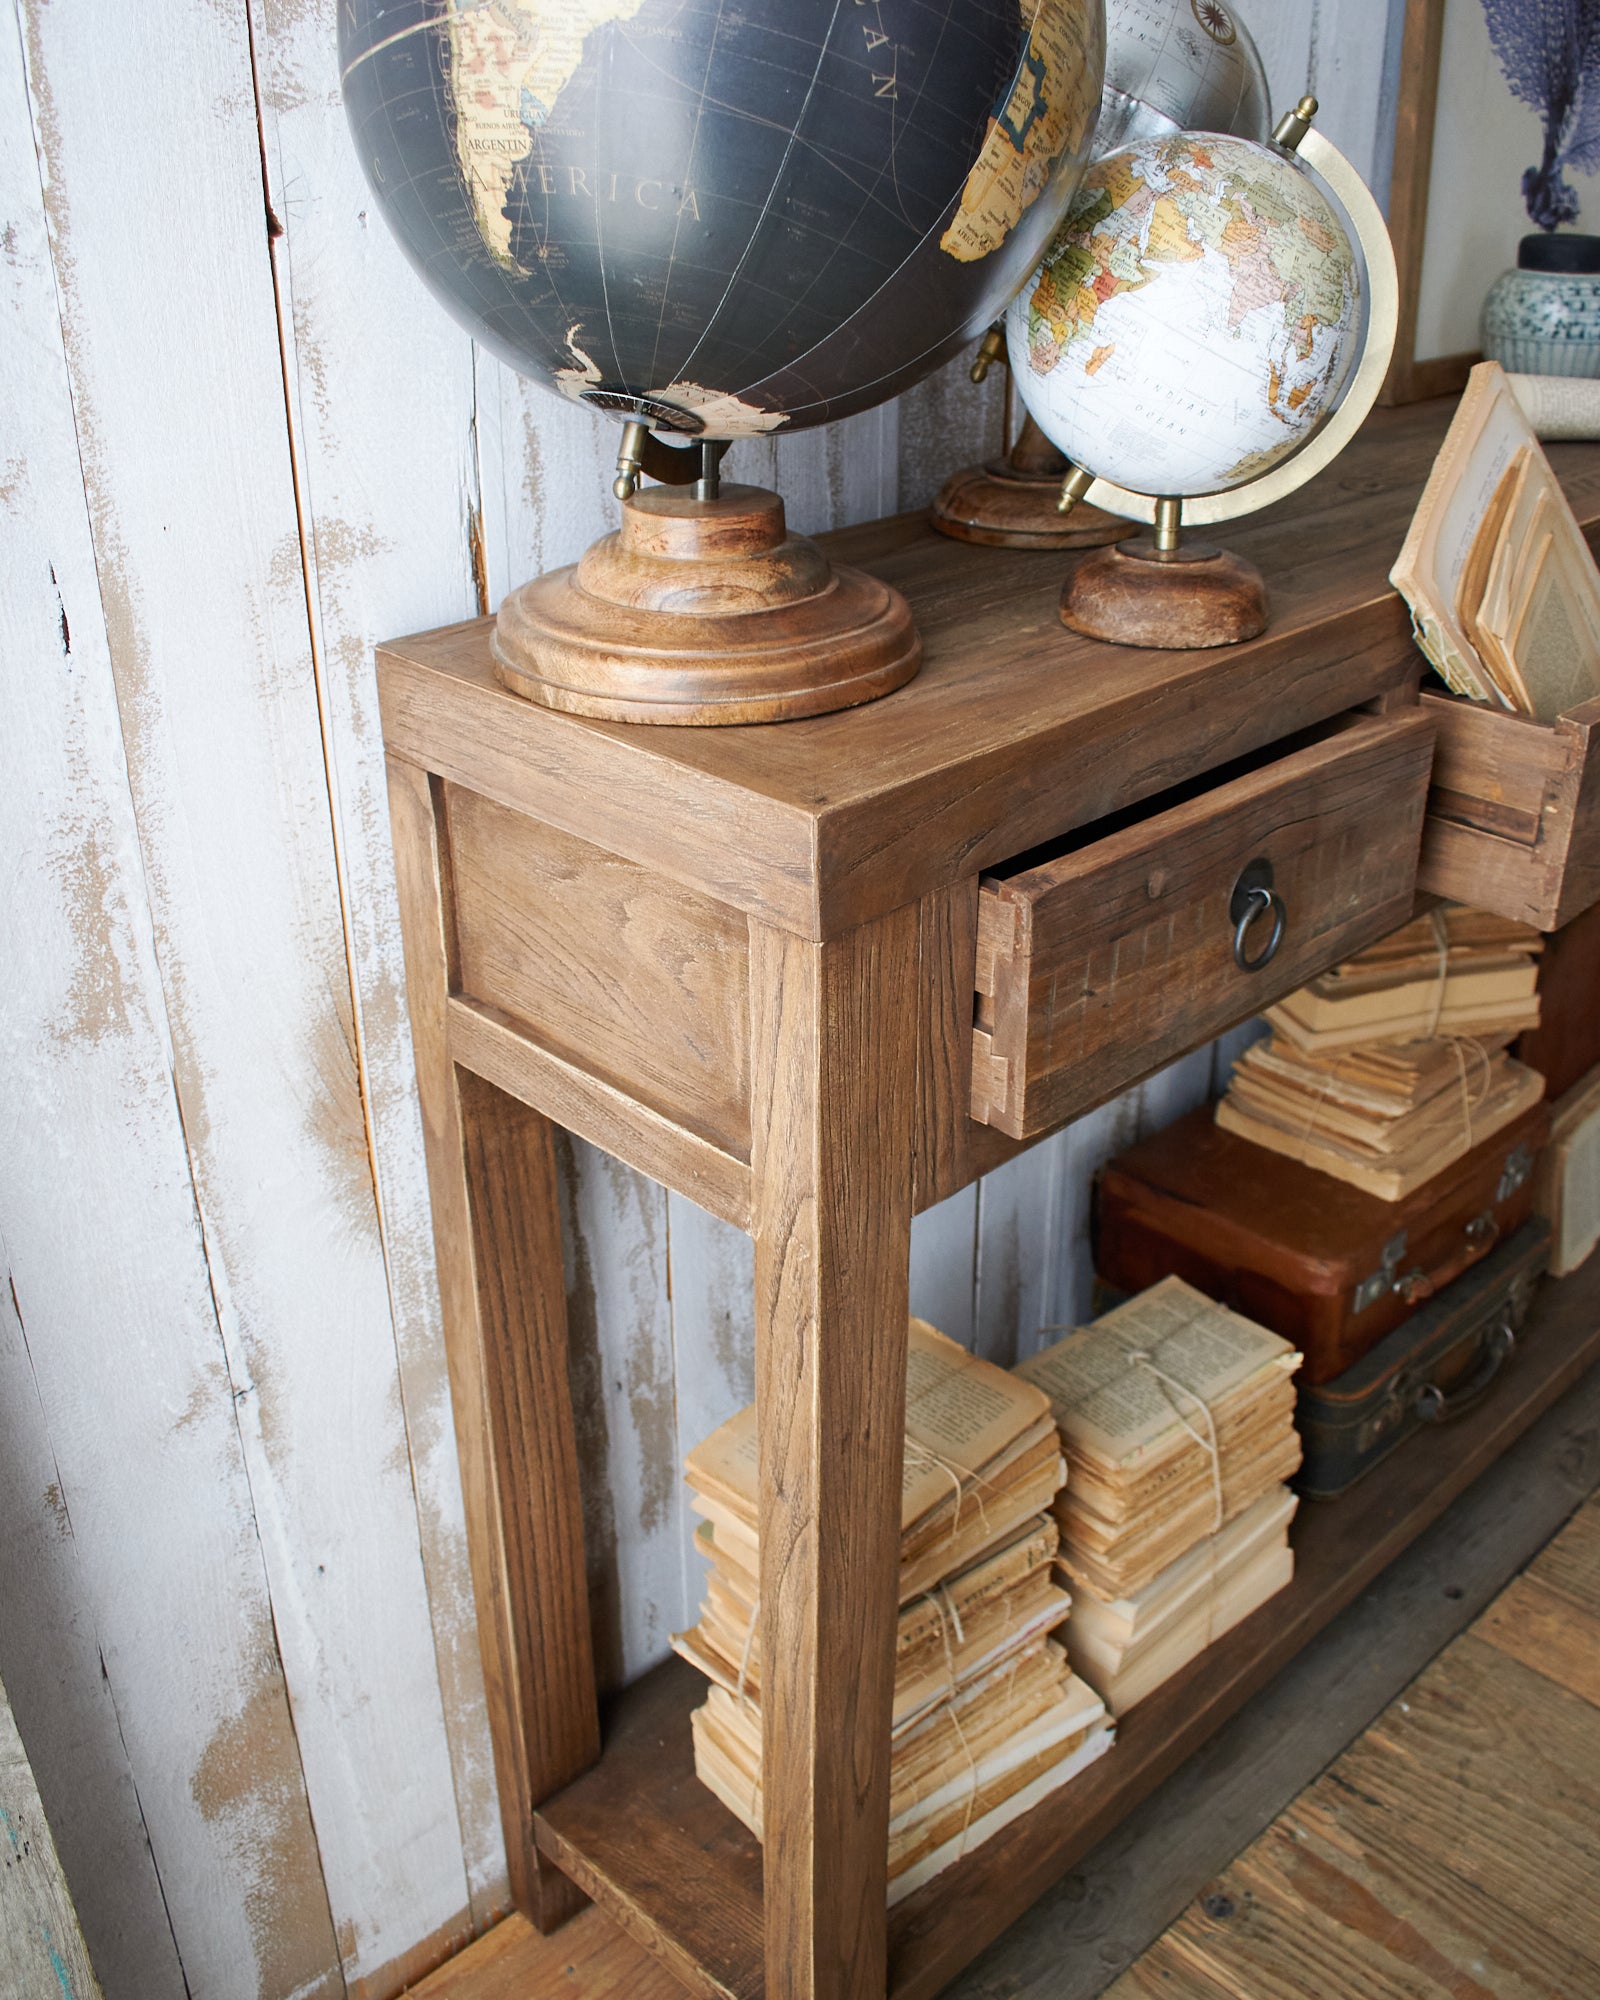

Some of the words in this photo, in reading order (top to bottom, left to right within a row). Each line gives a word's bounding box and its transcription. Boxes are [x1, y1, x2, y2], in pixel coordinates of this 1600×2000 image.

[503, 109, 548, 121] URUGUAY
[475, 122, 499, 131] BUENOS
[1143, 376, 1208, 418] INDIAN
